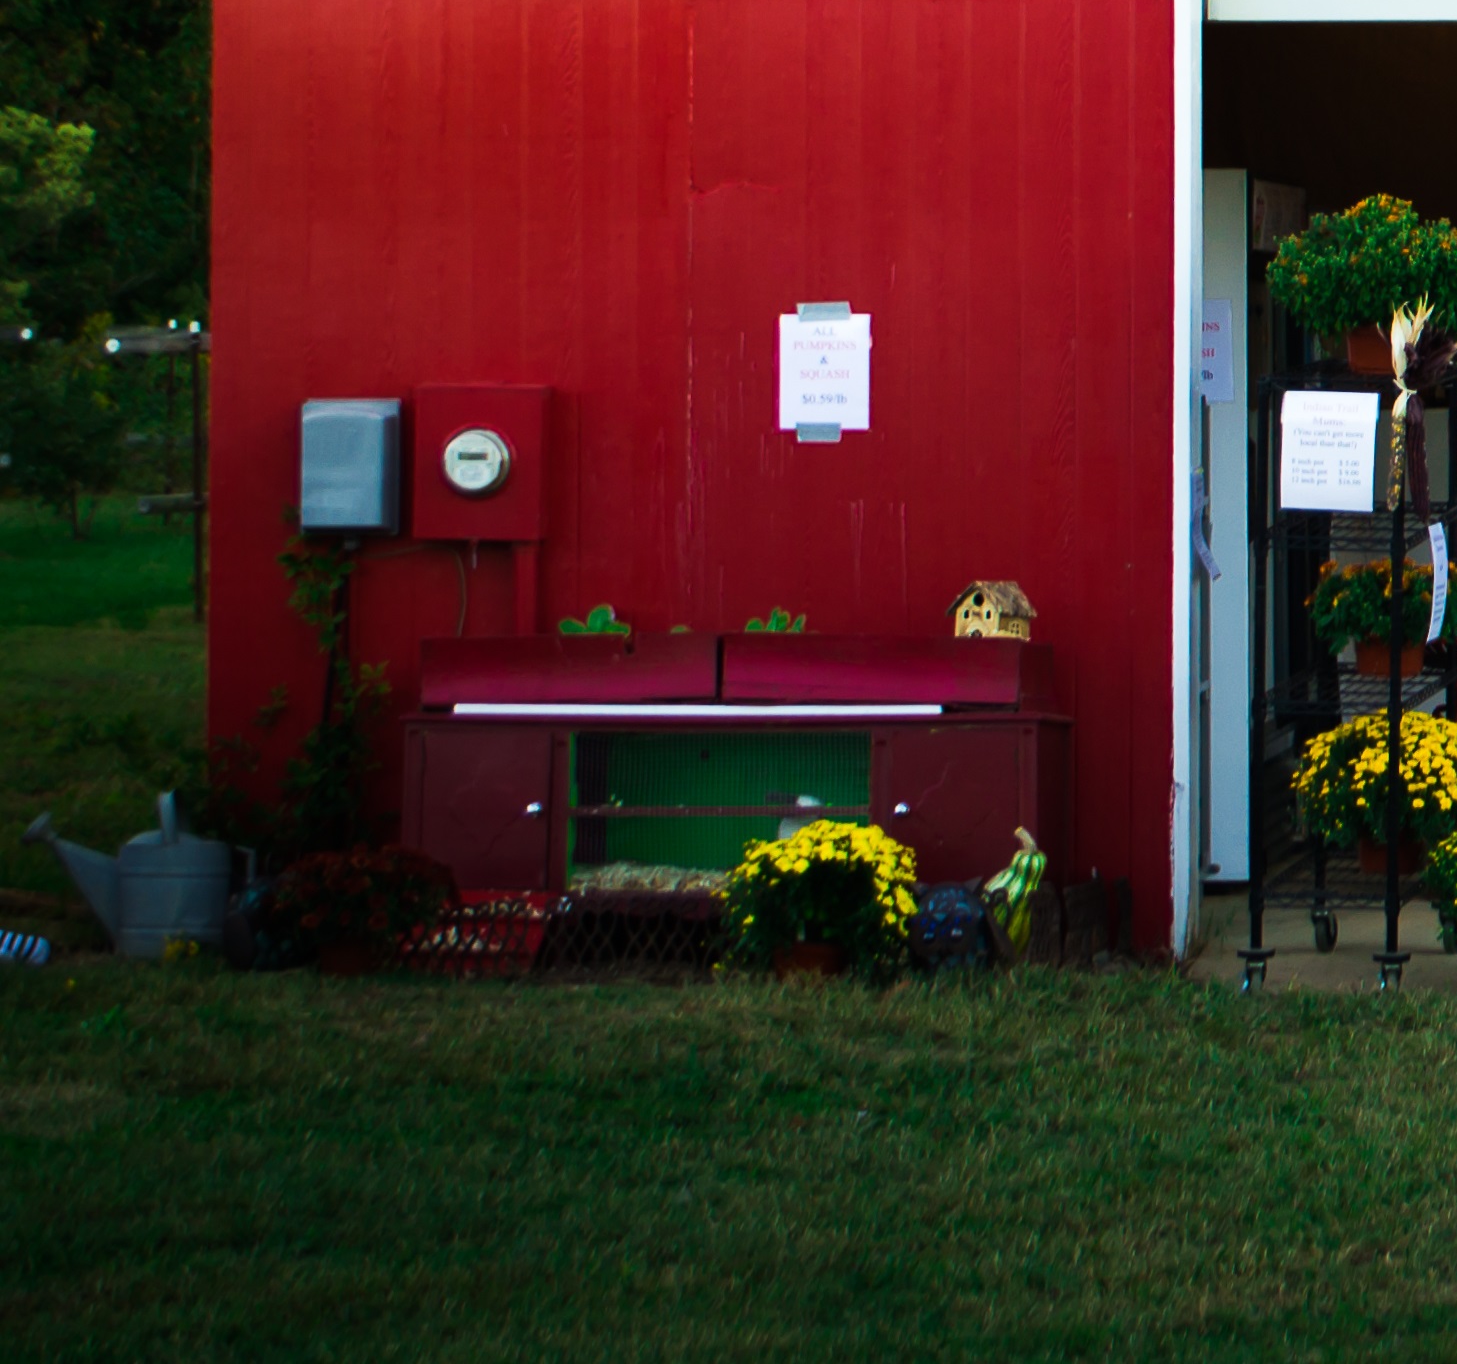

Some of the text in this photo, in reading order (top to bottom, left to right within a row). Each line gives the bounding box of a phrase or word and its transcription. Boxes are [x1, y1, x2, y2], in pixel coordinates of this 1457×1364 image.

[812, 326, 837, 336] ALL
[793, 340, 857, 350] PUMPKINS
[799, 369, 850, 380] SQUASH
